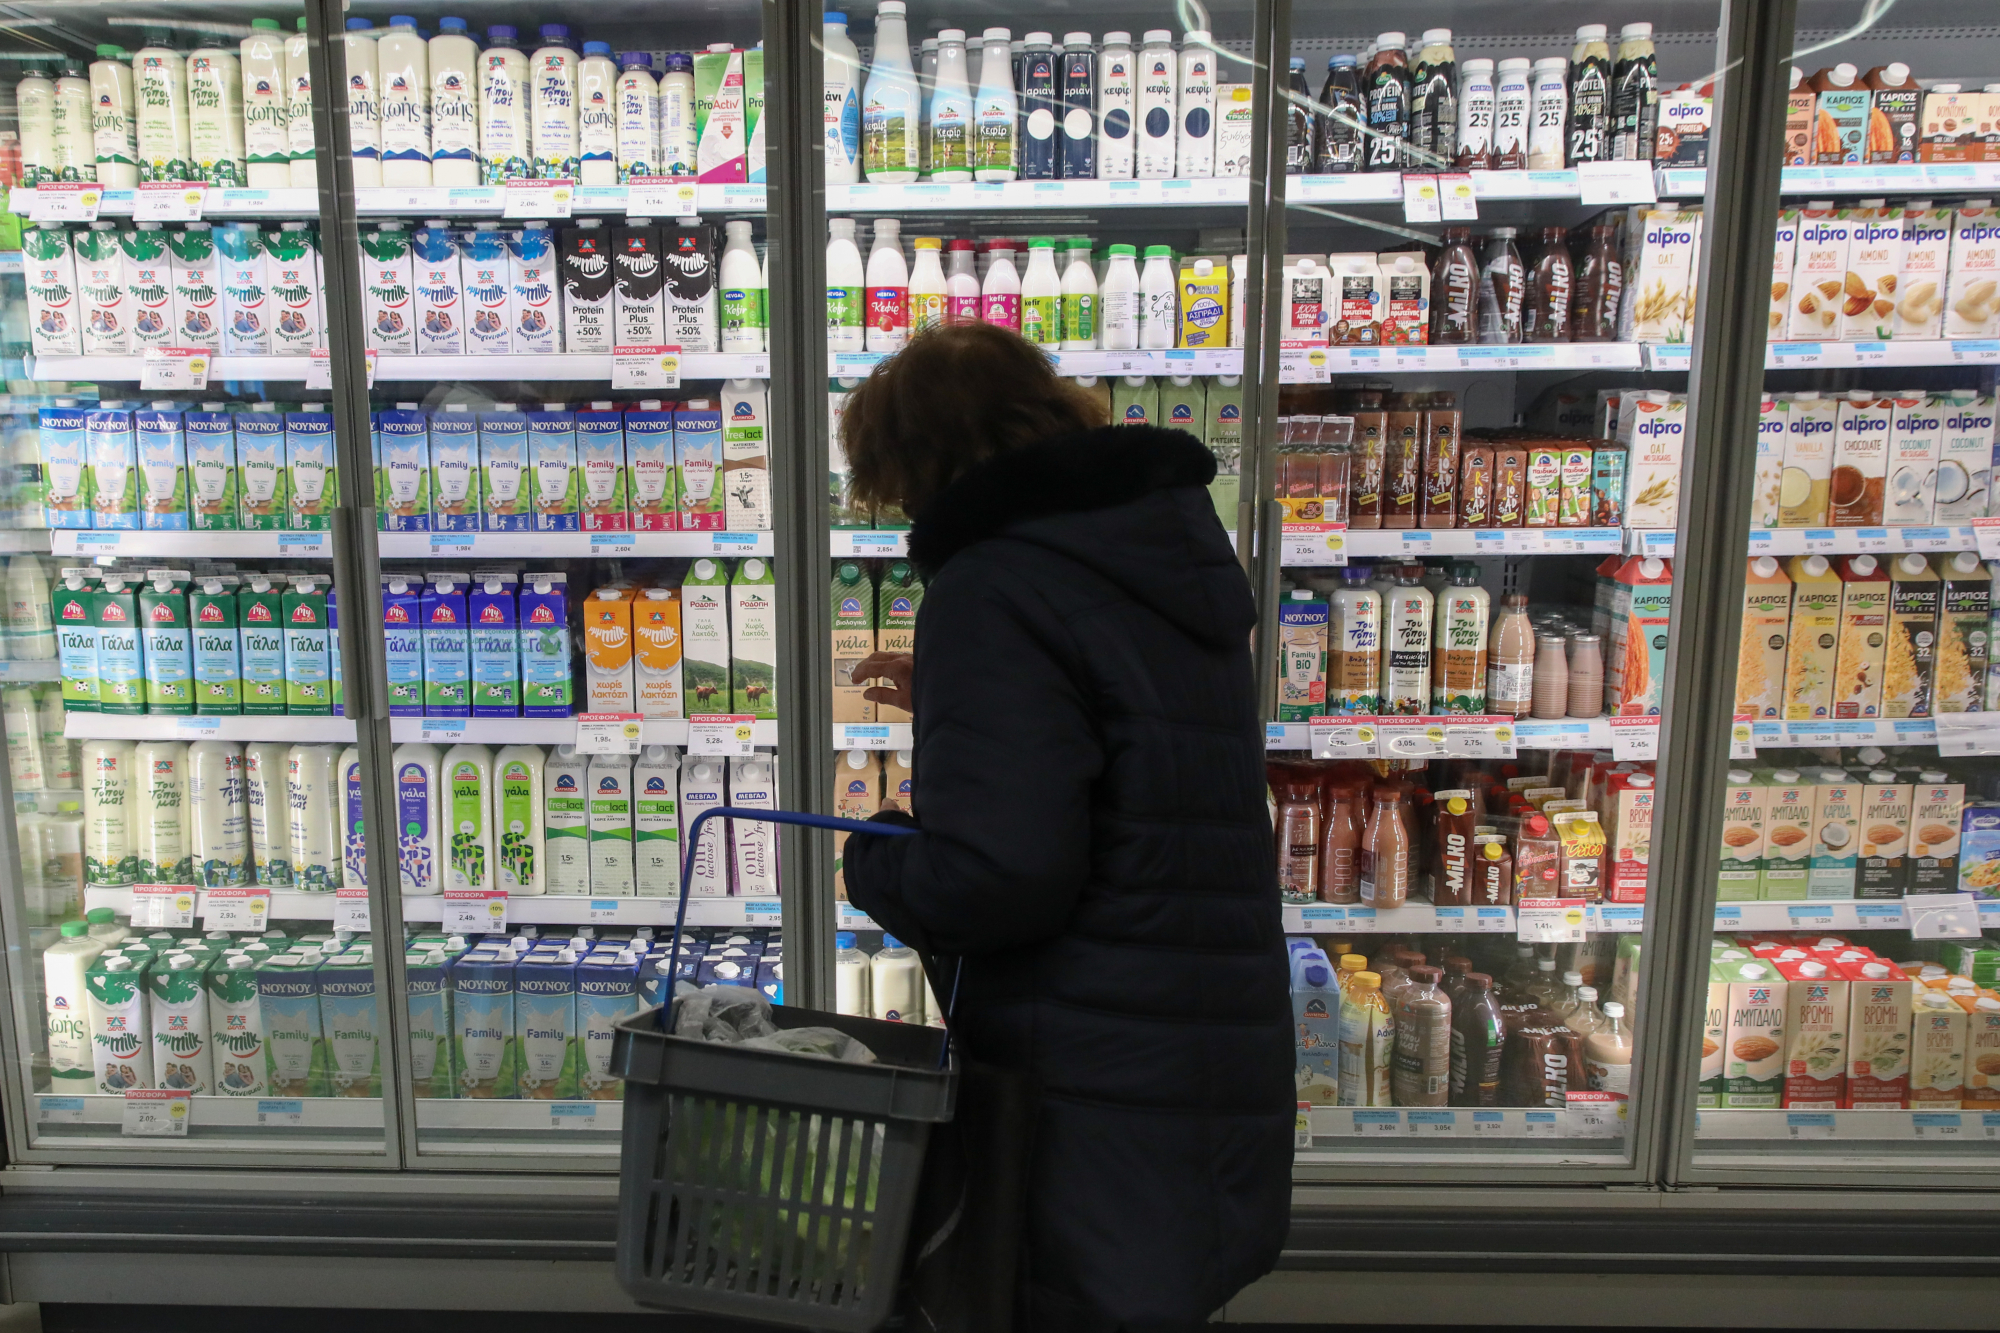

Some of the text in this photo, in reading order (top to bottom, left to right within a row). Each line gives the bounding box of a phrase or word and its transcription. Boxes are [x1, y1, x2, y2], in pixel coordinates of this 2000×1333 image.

[1827, 95, 1864, 104] ΚΑΡΠΟΣ
[1880, 92, 1917, 101] ΚΑΡΠΟΣ
[434, 98, 473, 122] ζωής
[698, 98, 739, 111] ProActiv
[246, 101, 286, 127] ζωής
[1469, 113, 1489, 127] 25
[1539, 113, 1559, 127] 25
[1647, 226, 1691, 248] alpro
[1657, 253, 1673, 266] OAT
[1860, 249, 1888, 261] ALMOND
[572, 306, 604, 315] Protein
[672, 305, 704, 314] Protein
[1189, 308, 1221, 320] ΑΣΠΡΑΔΙ
[580, 315, 598, 324] Plus
[678, 315, 698, 323] Plus
[576, 327, 602, 336] +50%
[676, 326, 701, 335] +50%
[1790, 416, 1833, 436] alpro
[1842, 415, 1886, 435] alpro
[1896, 414, 1939, 434] alpro
[1947, 412, 1991, 432] alpro
[1638, 418, 1682, 438] alpro
[1650, 443, 1665, 454] OAT
[1844, 439, 1882, 451] CHOCOLATE
[1900, 439, 1931, 449] COCONUT
[1951, 437, 1984, 449] COCONUT
[51, 456, 78, 467] Family
[391, 460, 418, 470] Family
[440, 459, 468, 470] Family
[539, 459, 568, 470] Family
[586, 459, 614, 469] Family
[636, 459, 664, 470] Family
[684, 458, 713, 469] Family
[1748, 596, 1787, 604] ΚΑΡΠΟΣ
[1800, 595, 1838, 603] ΚΑΡΠΟΣ
[1848, 594, 1886, 602] ΚΑΡΠΟΣ
[1355, 621, 1373, 629] Του
[1405, 620, 1422, 628] Του
[1455, 619, 1474, 628] Του
[692, 630, 718, 638] λακτόζη
[741, 630, 768, 638] λακτόζη
[1349, 629, 1377, 639] Τόπου
[1399, 628, 1427, 639] Τόπου
[1449, 628, 1480, 639] Τόπου
[102, 636, 134, 651] Γάλα
[199, 637, 232, 652] Γάλα
[291, 637, 323, 652] Γάλα
[836, 636, 869, 651] γάλα
[1356, 638, 1376, 647] μας
[1406, 637, 1426, 647] μας
[1454, 636, 1478, 646] μας
[1917, 648, 1930, 657] 32
[592, 689, 628, 700] λακτόζη
[641, 689, 677, 700] λακτόζη
[454, 788, 479, 798] γάλα
[505, 787, 529, 797] γάλα
[548, 801, 584, 811] freelact
[638, 802, 675, 813] freelact
[1867, 805, 1907, 819] ΑΜΥΓΔΑΛΟ
[756, 841, 764, 877] lactose
[1734, 1009, 1782, 1027] ΑΜΥΓΔΑΛΟ
[1800, 1005, 1833, 1024] ΒΡΩΜΗ
[1864, 1006, 1898, 1024] ΒΡΩΜΗ
[127, 1091, 167, 1099] ΠΡΟΣΦΟΡΑ
